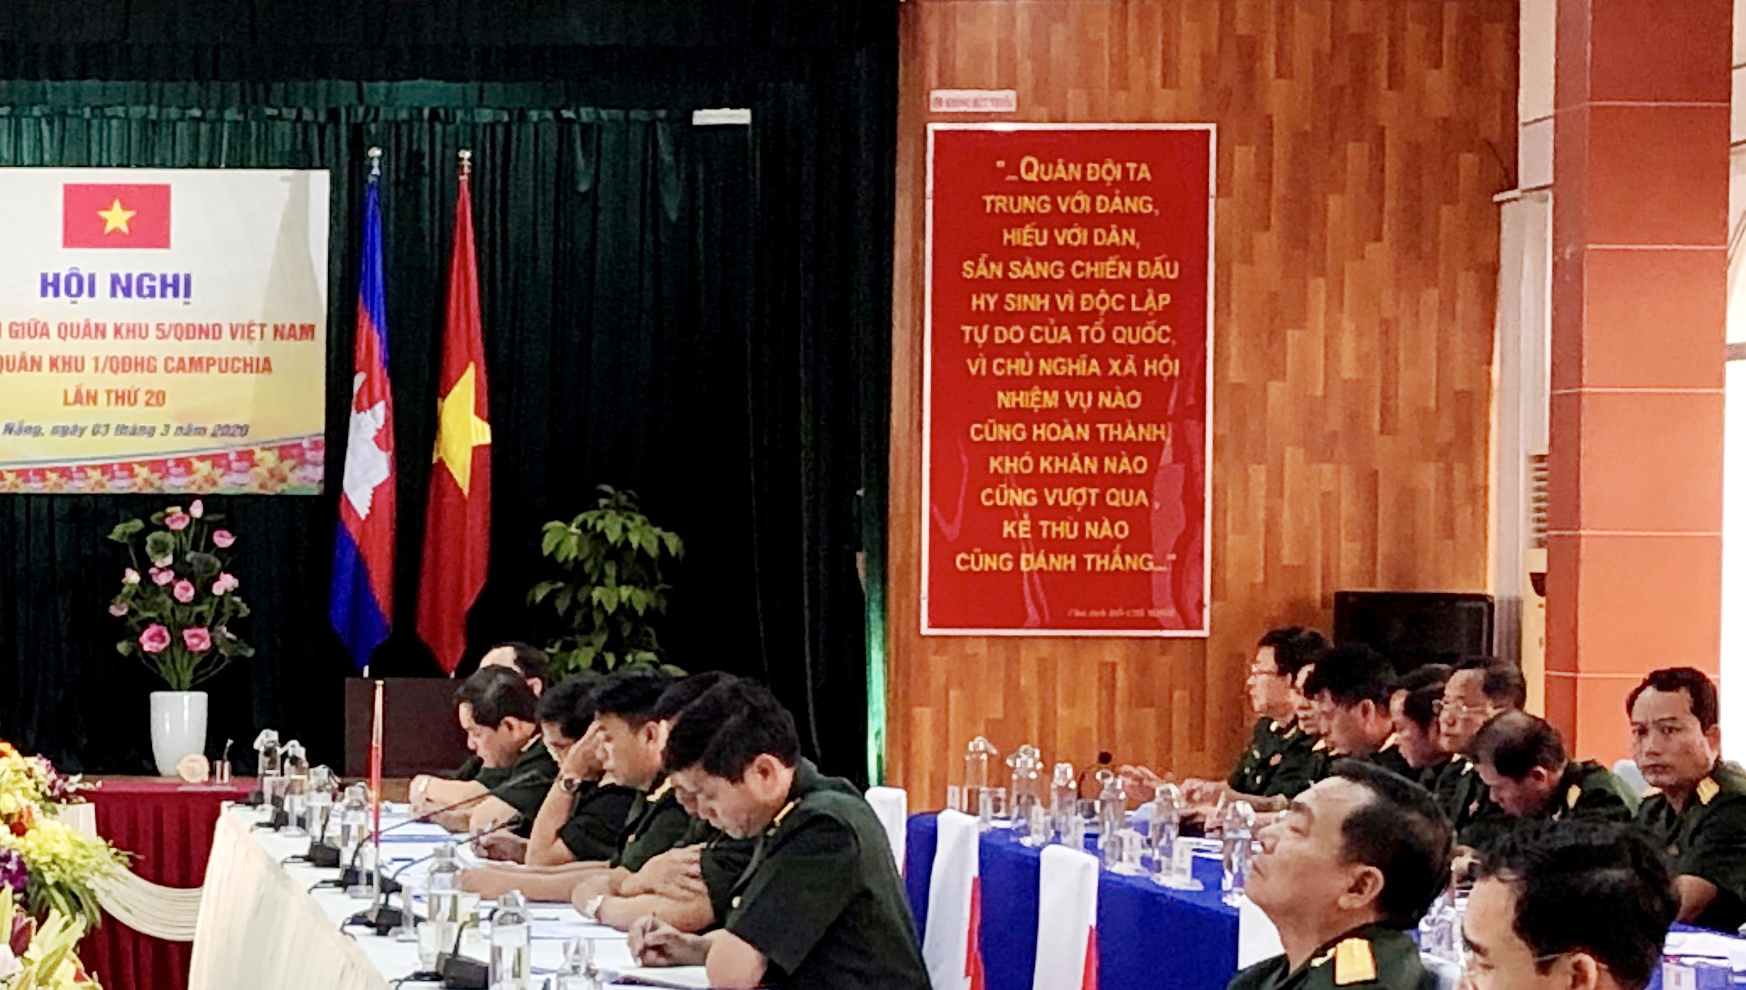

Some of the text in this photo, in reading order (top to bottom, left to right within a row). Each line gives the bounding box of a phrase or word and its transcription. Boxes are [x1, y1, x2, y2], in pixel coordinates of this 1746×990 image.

[1086, 158, 1121, 186] ĐỘI
[1125, 162, 1152, 182] TA
[982, 195, 1052, 213] TRUNG
[1057, 190, 1091, 213] VỚI
[1003, 222, 1048, 246] HIẾU
[1054, 222, 1088, 246] VỚI
[1071, 254, 1132, 279] CHIẾN
[40, 267, 192, 305] HỘI NGHỊ
[971, 293, 998, 311] HY
[1004, 293, 1050, 311] SINH
[1080, 288, 1125, 316] ĐỘC
[8, 317, 50, 339] GIỮA
[57, 317, 107, 341] QUÂN
[114, 322, 149, 340] KHU
[229, 319, 267, 344] VIỆT
[273, 323, 316, 341] NAM
[994, 325, 1024, 343] DO
[1030, 317, 1072, 343] CỦA
[49, 354, 85, 373] KHU
[164, 356, 272, 374] CAMPUCHIA
[1145, 354, 1180, 381] HỘI
[144, 389, 166, 407] 20
[997, 385, 1142, 413] NHIỆM VỤ NÀO
[161, 424, 170, 436] 3
[211, 424, 249, 437] 2020
[970, 418, 1027, 441] CŨNG
[1032, 418, 1090, 441] HOÀN
[989, 450, 1034, 474] KHÓ
[1104, 450, 1148, 474] NÀO
[980, 483, 1037, 506] CŨNG
[1085, 516, 1129, 539] NÀO
[955, 547, 1013, 571] CŨNG
[1020, 549, 1077, 571] ĐÁNH
